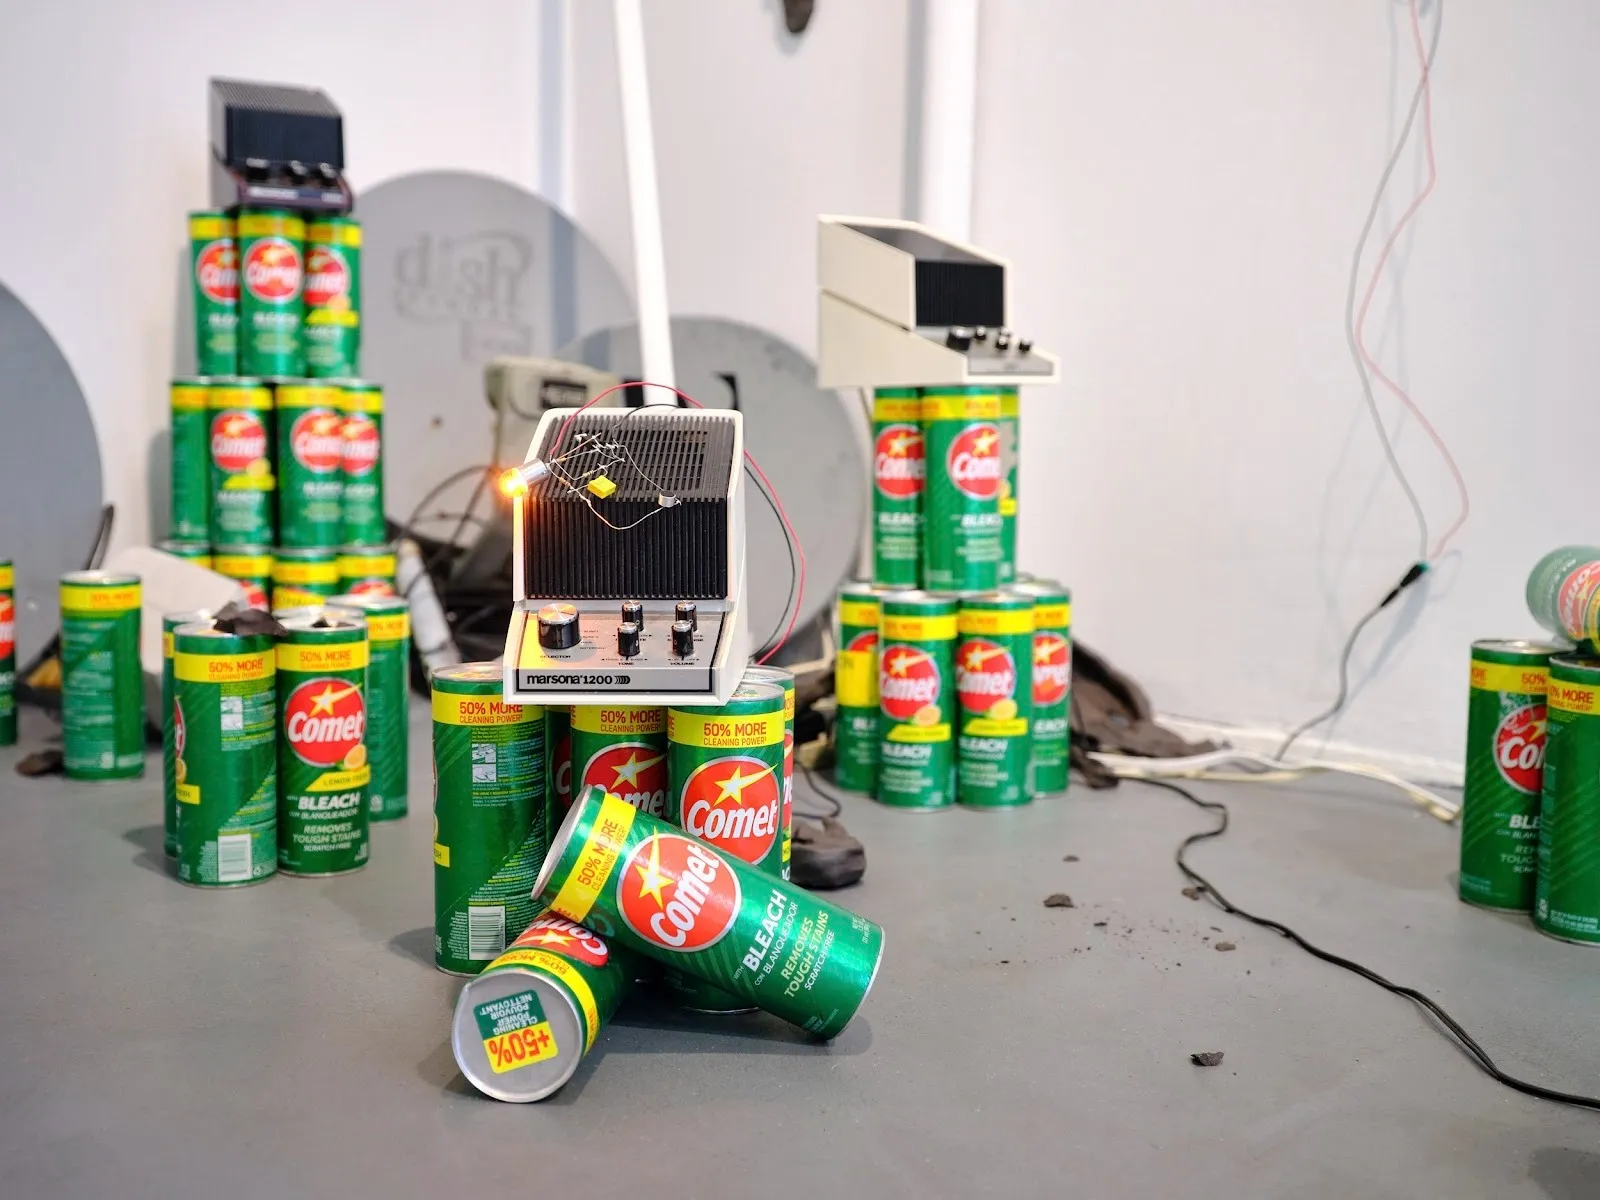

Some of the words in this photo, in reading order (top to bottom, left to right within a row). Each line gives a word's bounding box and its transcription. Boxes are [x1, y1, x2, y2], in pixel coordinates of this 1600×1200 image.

[391, 230, 518, 308] dish
[953, 452, 999, 480] Com
[326, 649, 352, 661] MORE
[236, 659, 264, 672] MORE
[583, 675, 613, 685] 1200
[1562, 687, 1595, 704] MORE
[460, 702, 486, 715] 50%
[490, 702, 523, 715] MORE
[600, 710, 626, 724] 50%
[630, 709, 661, 724] MORE
[287, 710, 365, 744] Comet
[459, 715, 495, 724] CLEANING
[600, 724, 633, 733] CLEANING
[703, 723, 731, 737] 50%
[735, 721, 767, 736] MORE
[703, 737, 739, 746] CLEANING
[298, 792, 361, 811] BLEACH
[304, 823, 353, 835] REMOVES
[687, 799, 779, 840] Comet
[293, 834, 330, 844] TOUGH
[331, 829, 362, 842] STAINS
[577, 854, 602, 886] 50%
[592, 818, 619, 856] MORE
[591, 851, 616, 892] CLEANING
[650, 844, 720, 947] Comet
[733, 965, 745, 982] WITH
[742, 889, 788, 973] BLEACH
[754, 972, 766, 986] CON
[762, 901, 799, 976] BLANQUEADOR
[780, 916, 814, 981] REMOVES
[783, 951, 815, 998] TOUGH
[808, 910, 829, 953] STAINS
[490, 1003, 530, 1021] POUVOIR
[493, 1014, 539, 1036] CLEANING
[488, 1028, 550, 1068] +50%
